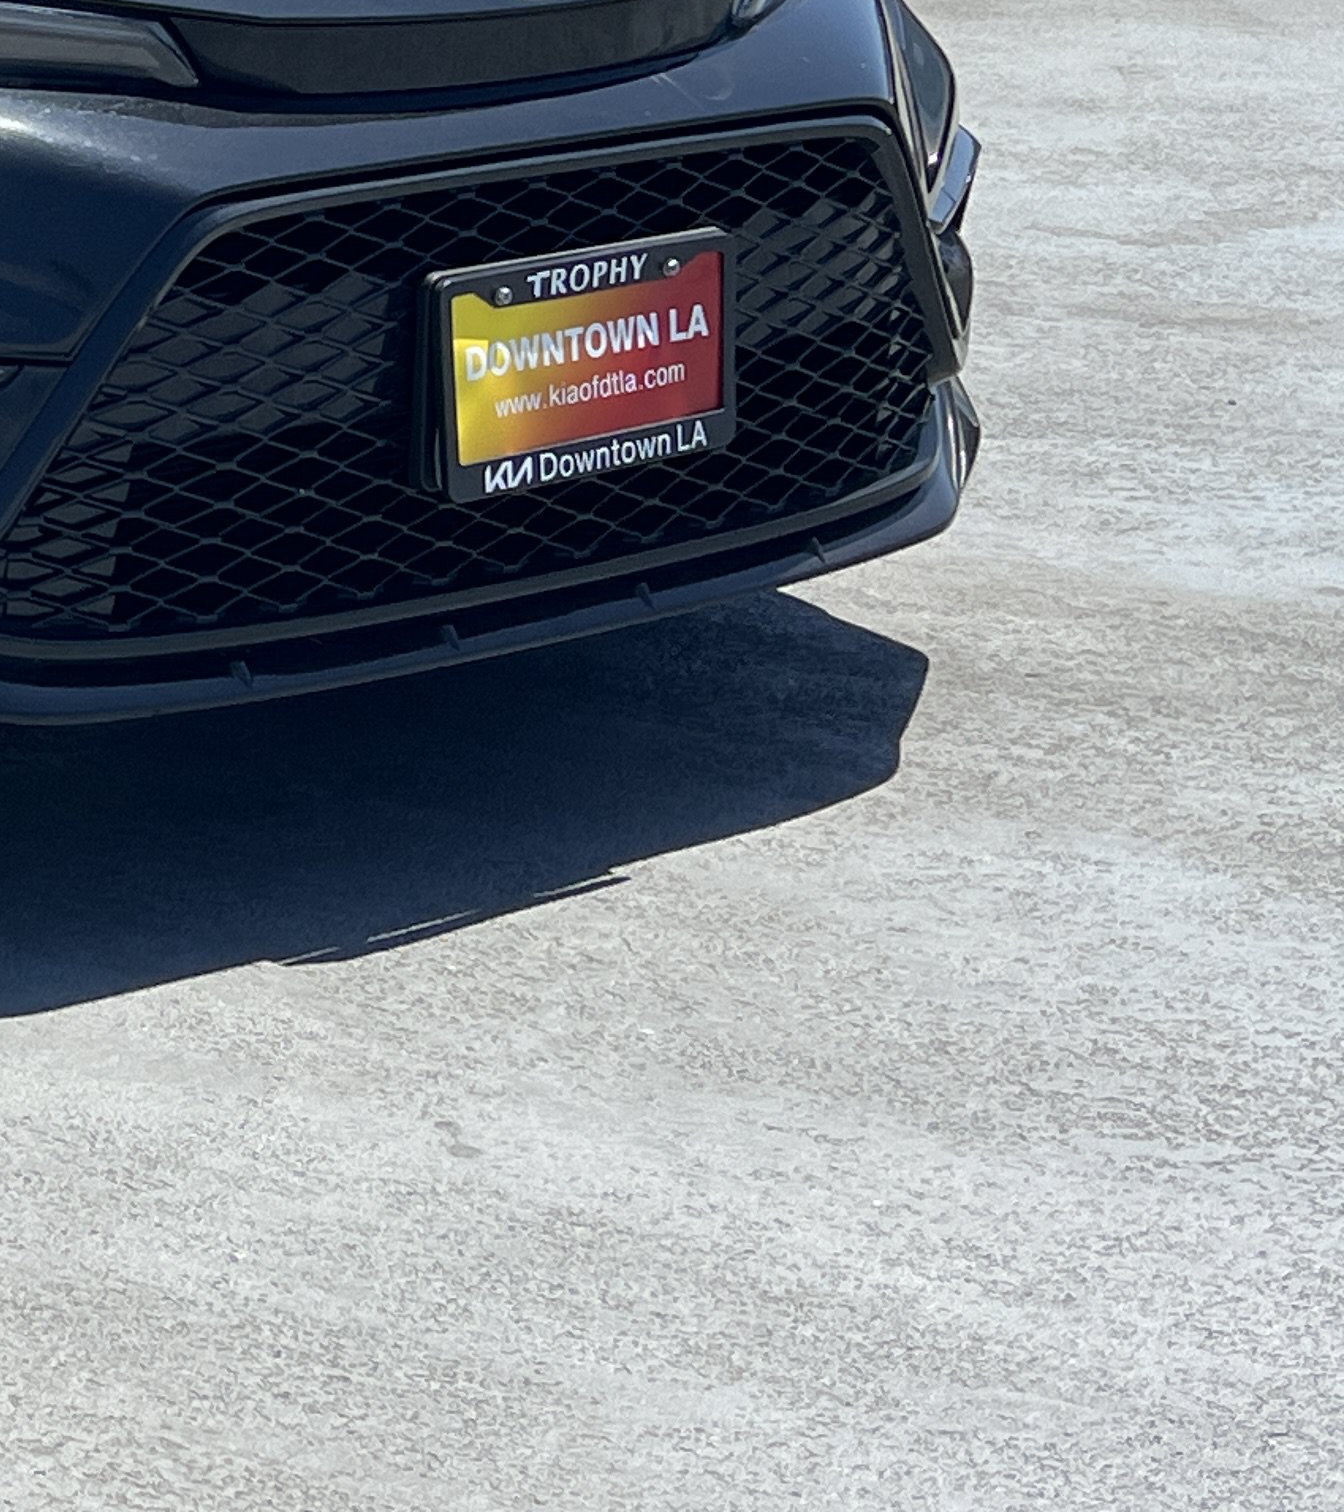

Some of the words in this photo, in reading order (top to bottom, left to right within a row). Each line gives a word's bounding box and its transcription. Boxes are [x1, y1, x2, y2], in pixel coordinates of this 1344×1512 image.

[527, 253, 648, 298] TROPHY
[465, 311, 660, 382] DOWNTOWN
[668, 304, 710, 343] LA
[494, 361, 686, 418] www.kiaofdtla.com
[539, 432, 672, 482] Downtown
[676, 419, 709, 452] LA
